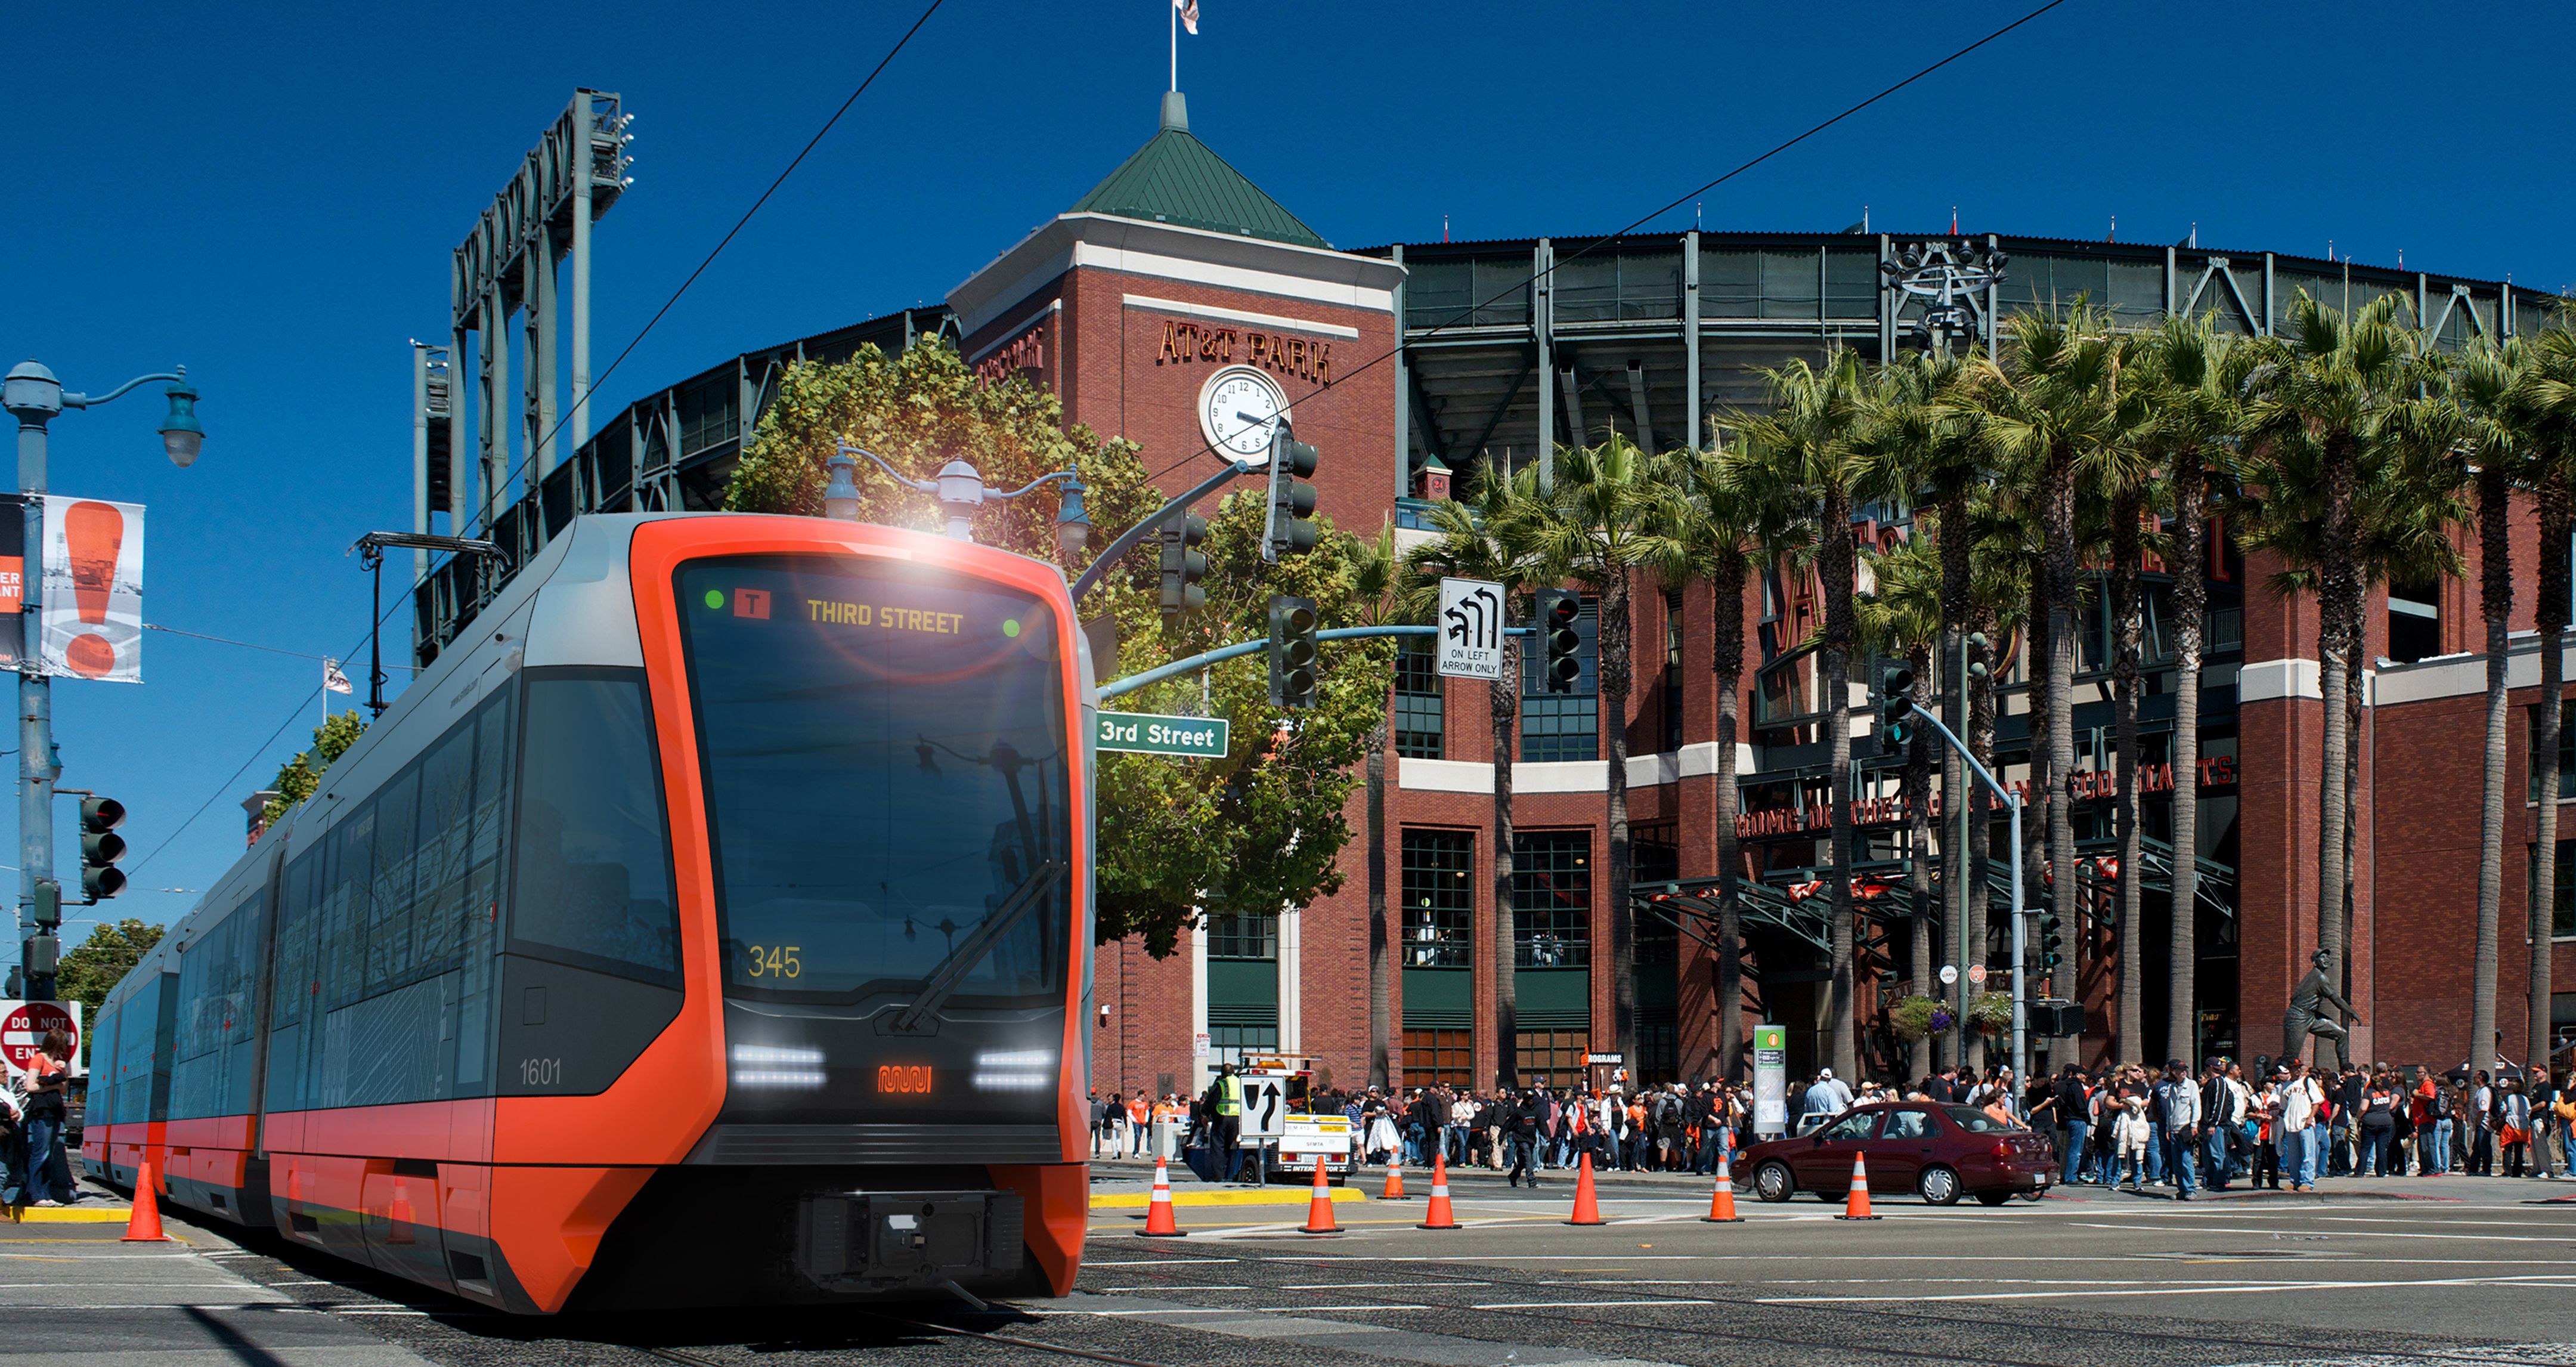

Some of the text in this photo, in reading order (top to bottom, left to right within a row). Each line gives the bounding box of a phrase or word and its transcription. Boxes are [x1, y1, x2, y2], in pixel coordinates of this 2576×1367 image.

[1157, 320, 1330, 384] AT&T PARK
[1228, 385, 1236, 394] 11
[1240, 382, 1249, 391] 12
[1256, 388, 1260, 397] 1
[1218, 394, 1227, 403] 10
[1265, 400, 1271, 409] 2
[1213, 408, 1218, 417] 9
[1270, 415, 1275, 424] 3
[1218, 423, 1223, 432] 8
[1264, 429, 1270, 438] 4
[1228, 434, 1234, 444] 7
[1255, 438, 1261, 447] 5
[1241, 441, 1247, 450] 6
[0, 585, 21, 597] NT
[745, 593, 760, 614] T
[807, 599, 964, 634] THIRD STREET
[1451, 649, 1489, 661] ON LEFT
[1442, 661, 1497, 674] ARROW ONLY
[1100, 720, 1214, 747] 3rd Street
[1735, 807, 1800, 838] HOME
[1850, 796, 1894, 825] THE
[748, 945, 800, 978] 345
[11, 1017, 67, 1029] DO NOT
[1588, 1054, 1622, 1063] ROGRAMS
[520, 1057, 561, 1085] 1601
